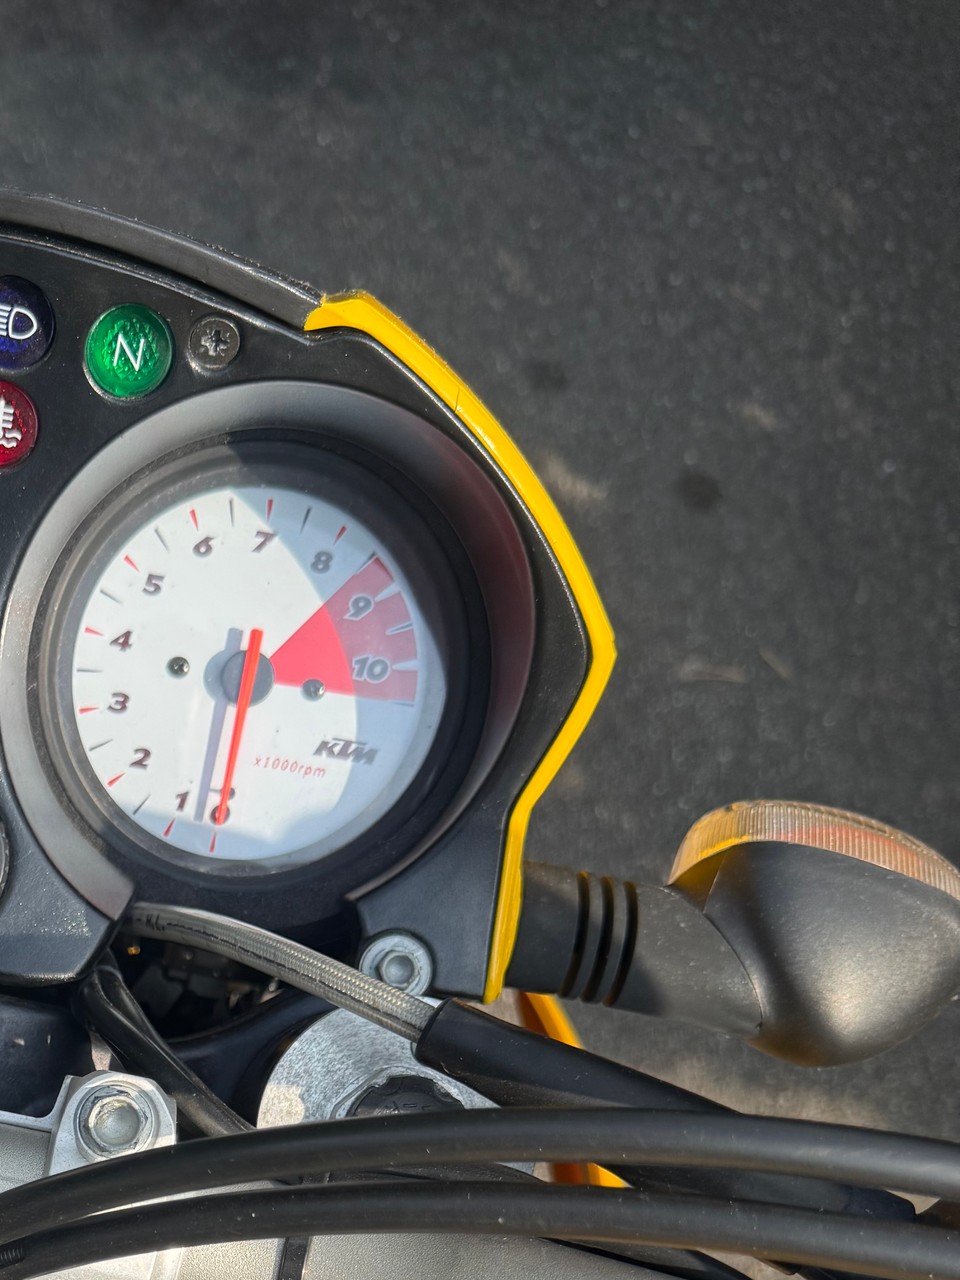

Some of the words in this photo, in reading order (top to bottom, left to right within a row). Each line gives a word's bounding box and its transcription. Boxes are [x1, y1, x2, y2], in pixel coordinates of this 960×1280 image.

[112, 332, 145, 372] N
[191, 535, 215, 558] 6
[250, 530, 278, 554] 7
[309, 550, 333, 574] 8
[142, 573, 166, 597] 5
[344, 595, 374, 621] 9
[110, 629, 133, 652] 4
[351, 655, 390, 684] 10
[107, 692, 131, 714] 3
[129, 748, 152, 770] 2
[312, 736, 380, 766] KTM
[253, 756, 327, 779] x1000rpm
[175, 790, 191, 812] 1
